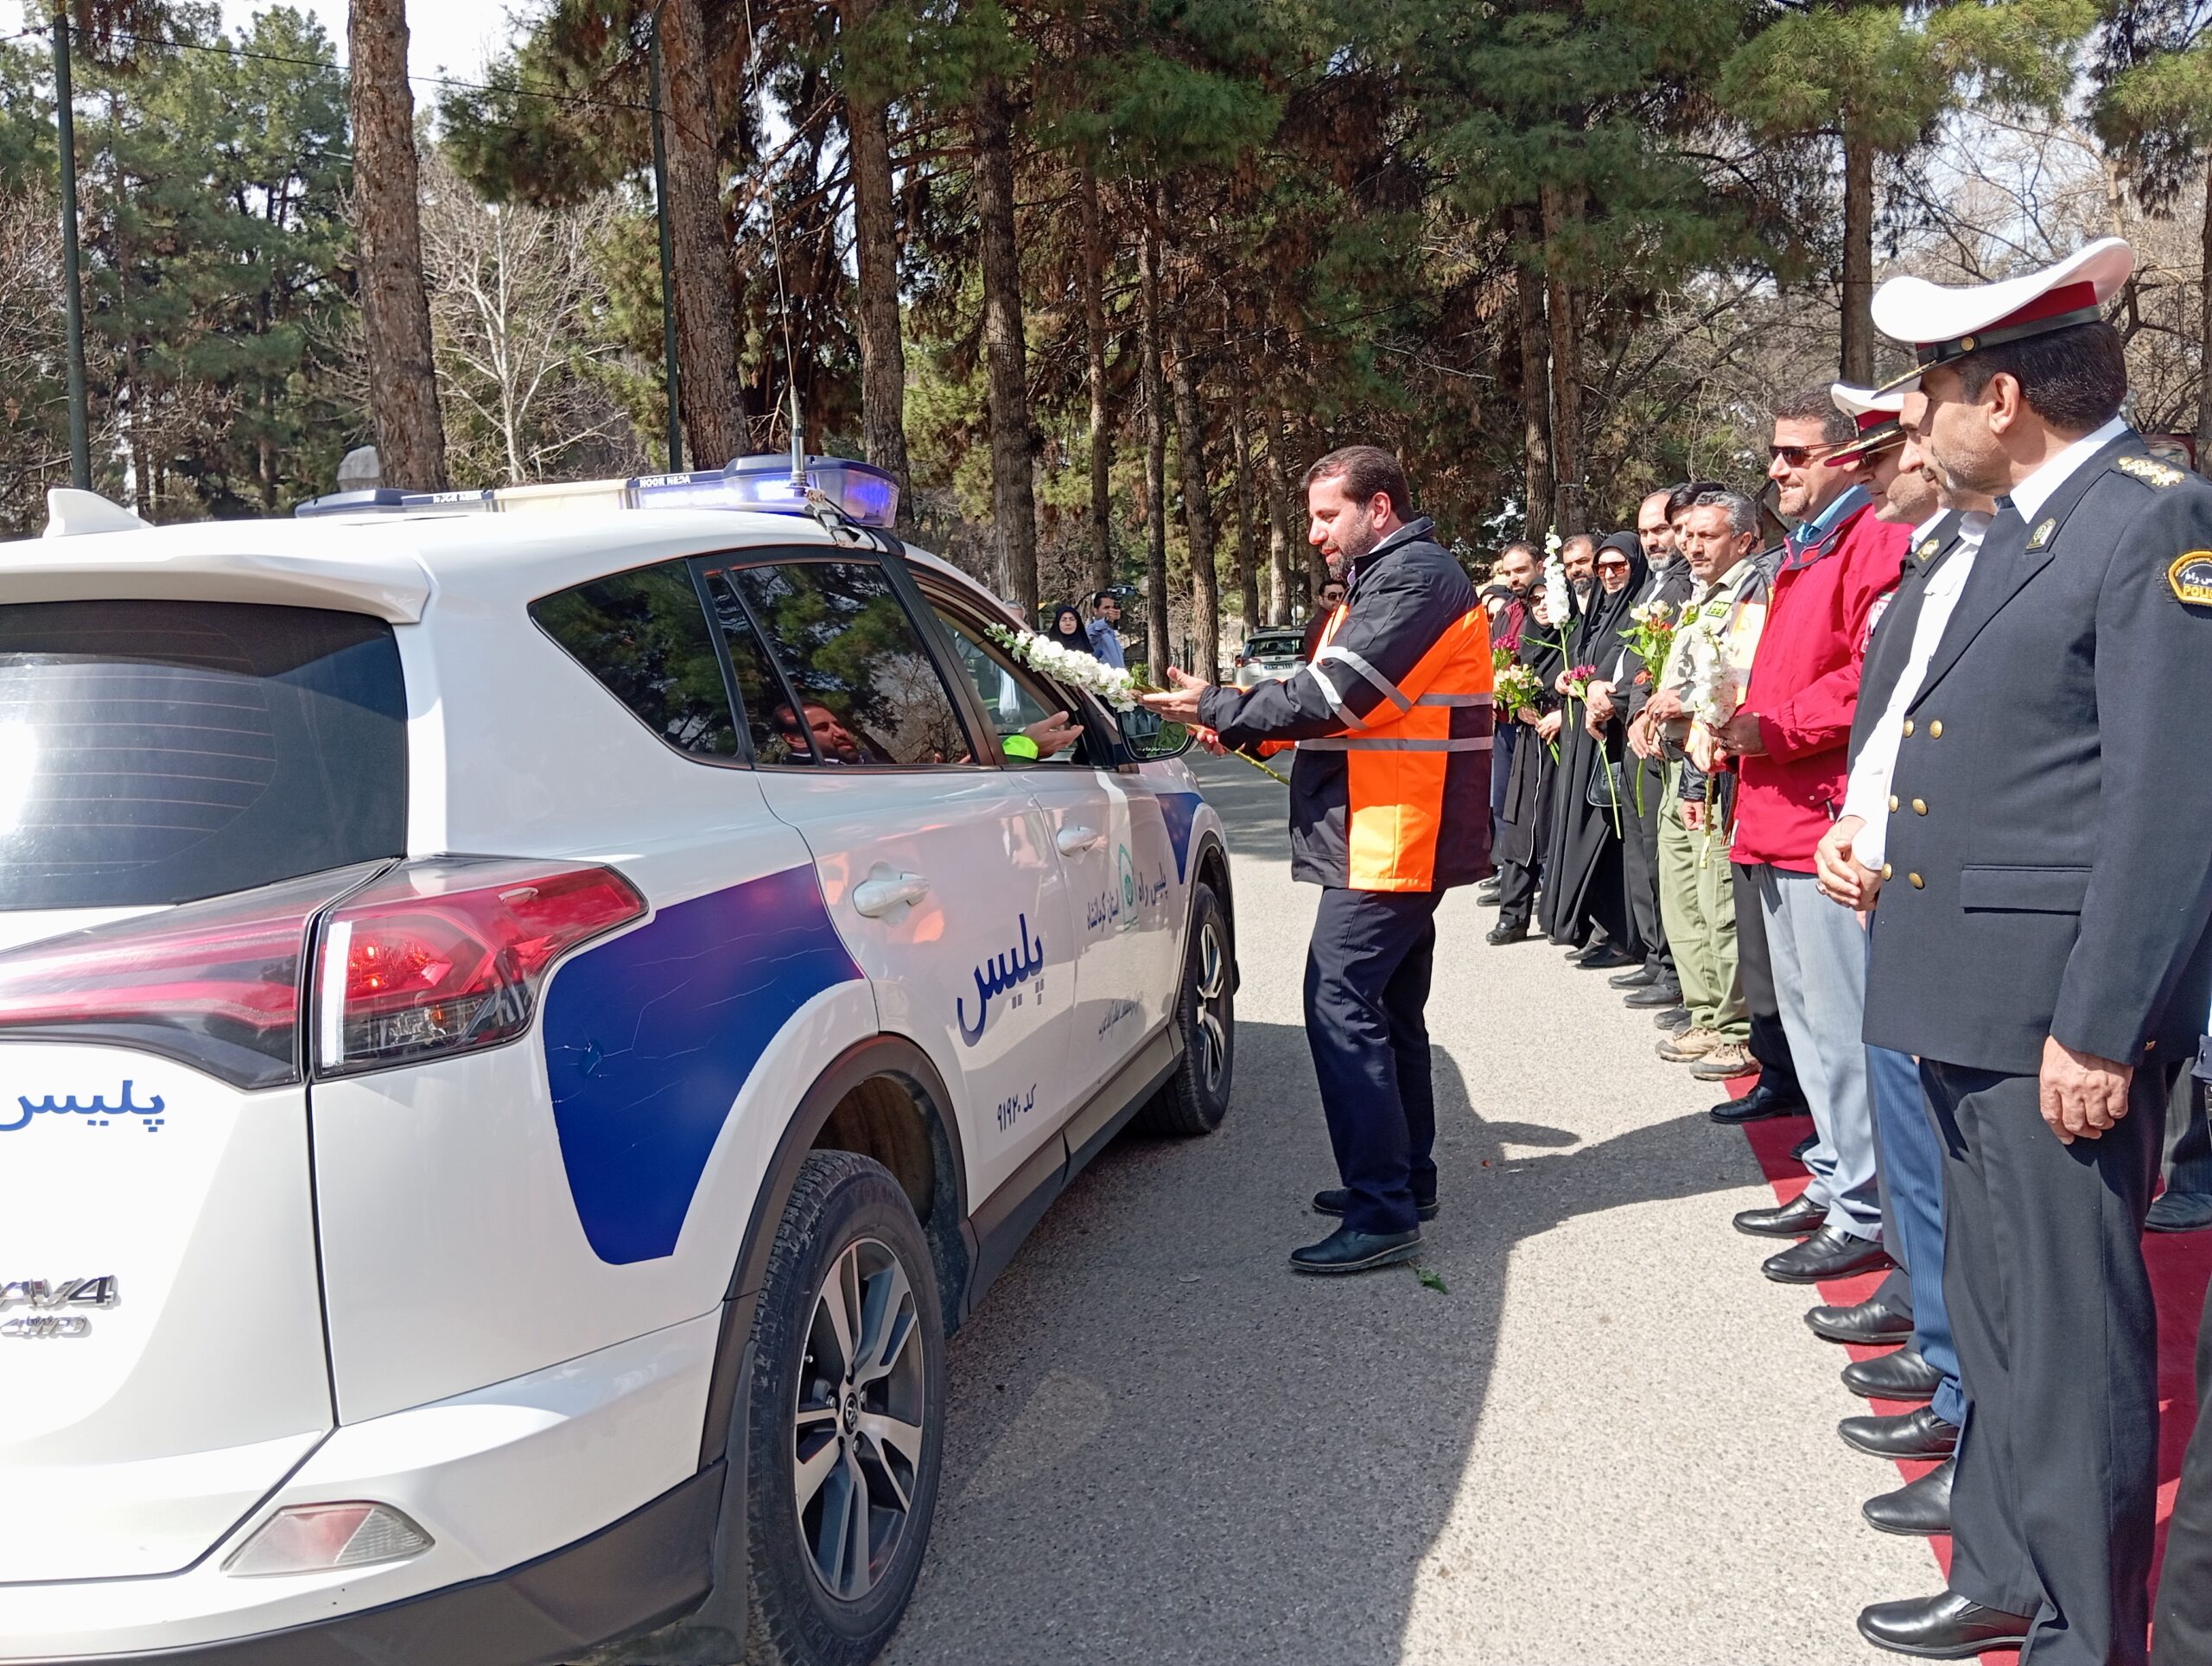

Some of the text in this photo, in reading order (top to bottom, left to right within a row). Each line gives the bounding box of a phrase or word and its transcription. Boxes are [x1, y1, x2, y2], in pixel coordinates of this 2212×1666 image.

[639, 477, 665, 488] NOOR
[1137, 870, 1149, 908] راه
[1150, 861, 1169, 906] پلیس
[957, 912, 1045, 1048] پلیس
[0, 1079, 166, 1133] پلیس
[1023, 1082, 1037, 1113] کد
[0, 1275, 120, 1310] AV4
